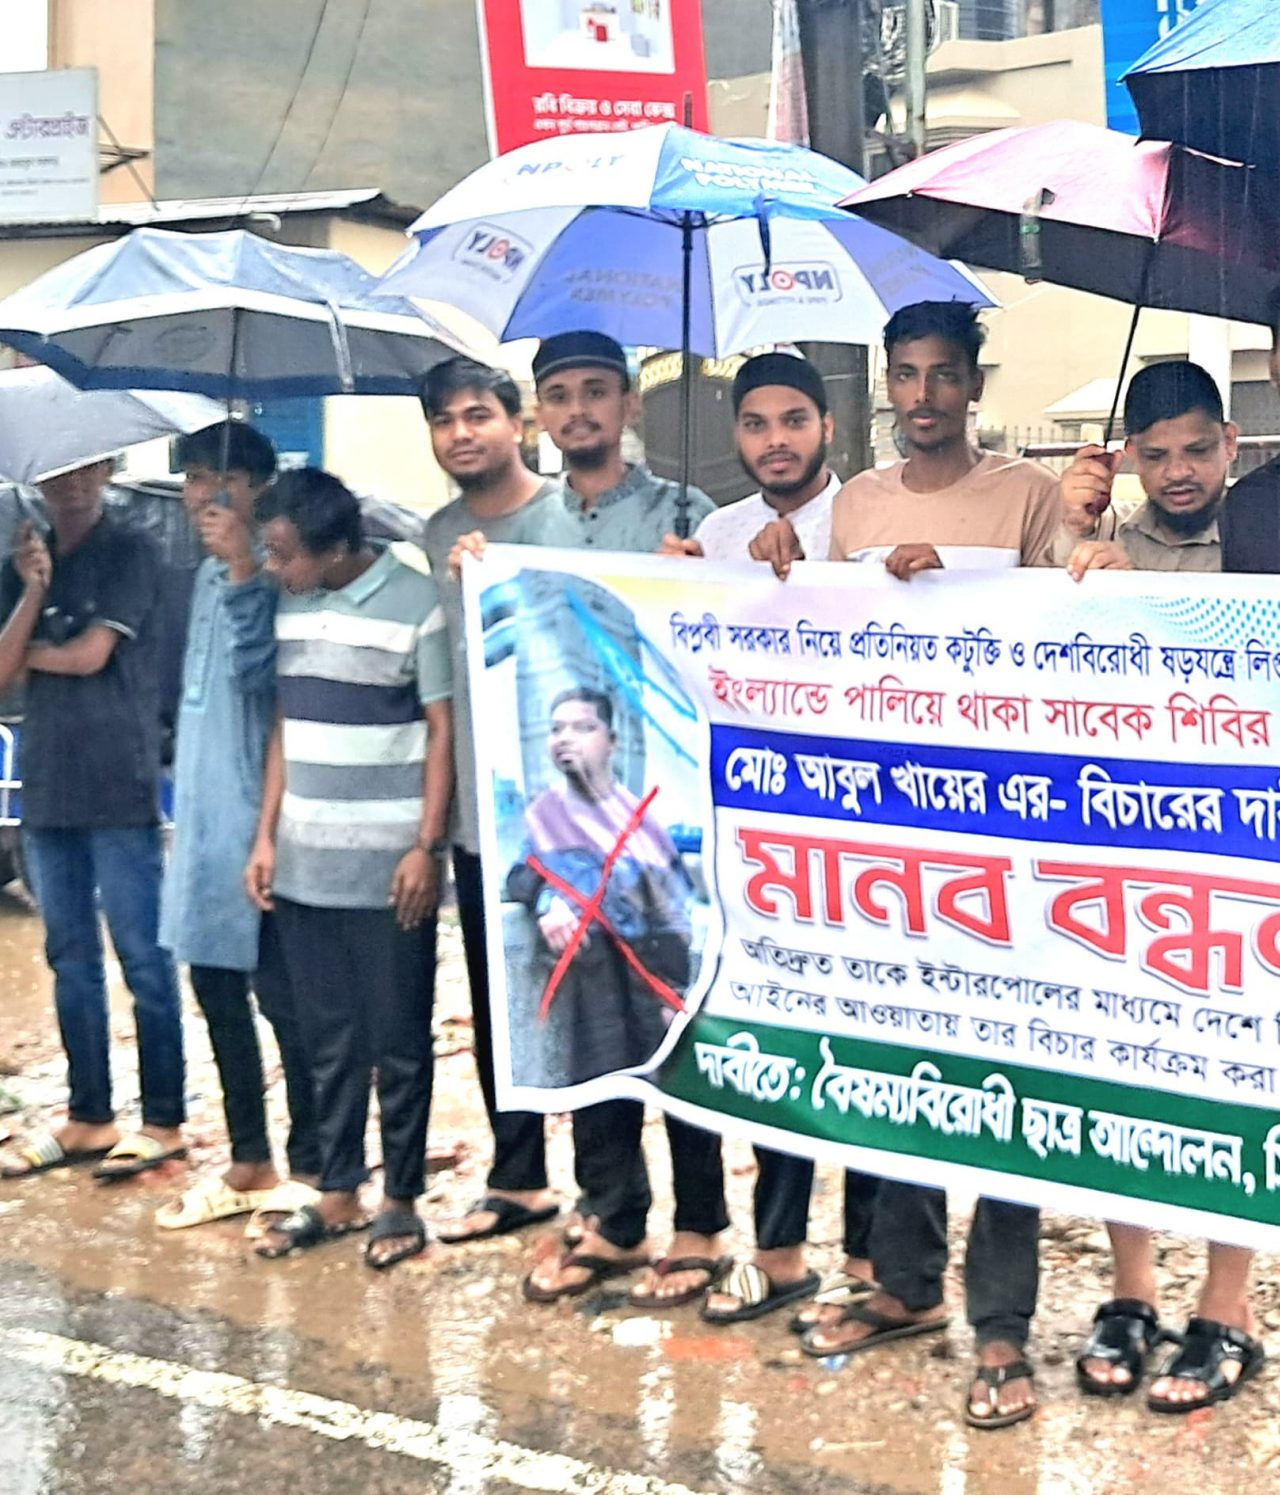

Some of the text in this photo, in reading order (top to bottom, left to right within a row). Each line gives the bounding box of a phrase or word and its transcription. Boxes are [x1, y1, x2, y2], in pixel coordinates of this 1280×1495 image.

[517, 154, 625, 177] NPLY
[727, 624, 792, 653] সরকার
[797, 619, 842, 660] নিয়ে
[850, 621, 939, 664] প্রতিনিয়ত
[1009, 641, 1025, 667] ও
[1034, 632, 1151, 676] দেশবিরোধী
[708, 664, 833, 716] ইংল্যান্ডে
[844, 675, 946, 728] পালিয়ে
[957, 690, 1032, 735] থাকা
[1041, 696, 1154, 741] সাবেক
[1165, 691, 1271, 747] শিবির
[725, 746, 787, 796] মোঃ
[793, 752, 882, 815] আবুল
[890, 760, 988, 815] খায়ের
[1077, 764, 1225, 834] বিচারের
[736, 827, 1013, 946] মানব
[730, 980, 828, 1017] আইনের
[835, 996, 961, 1038] আওয়াতায়
[970, 1015, 1018, 1051] তার
[1027, 1017, 1097, 1063] বিচার
[1106, 1038, 1209, 1083] কার্যক্রম
[1219, 1059, 1277, 1094] করা
[740, 936, 834, 975] অতিদ্রুত
[840, 955, 909, 987] তাকে
[917, 956, 1081, 1013] ইন্টারপোলের
[1092, 988, 1182, 1028] মাধ্যমে
[1193, 1006, 1264, 1044] দেশে
[811, 1036, 1016, 1142] বৈষম্যবিরোধী
[1021, 1096, 1086, 1159] ছাত্র
[1087, 1109, 1256, 1197] আন্দোলন,
